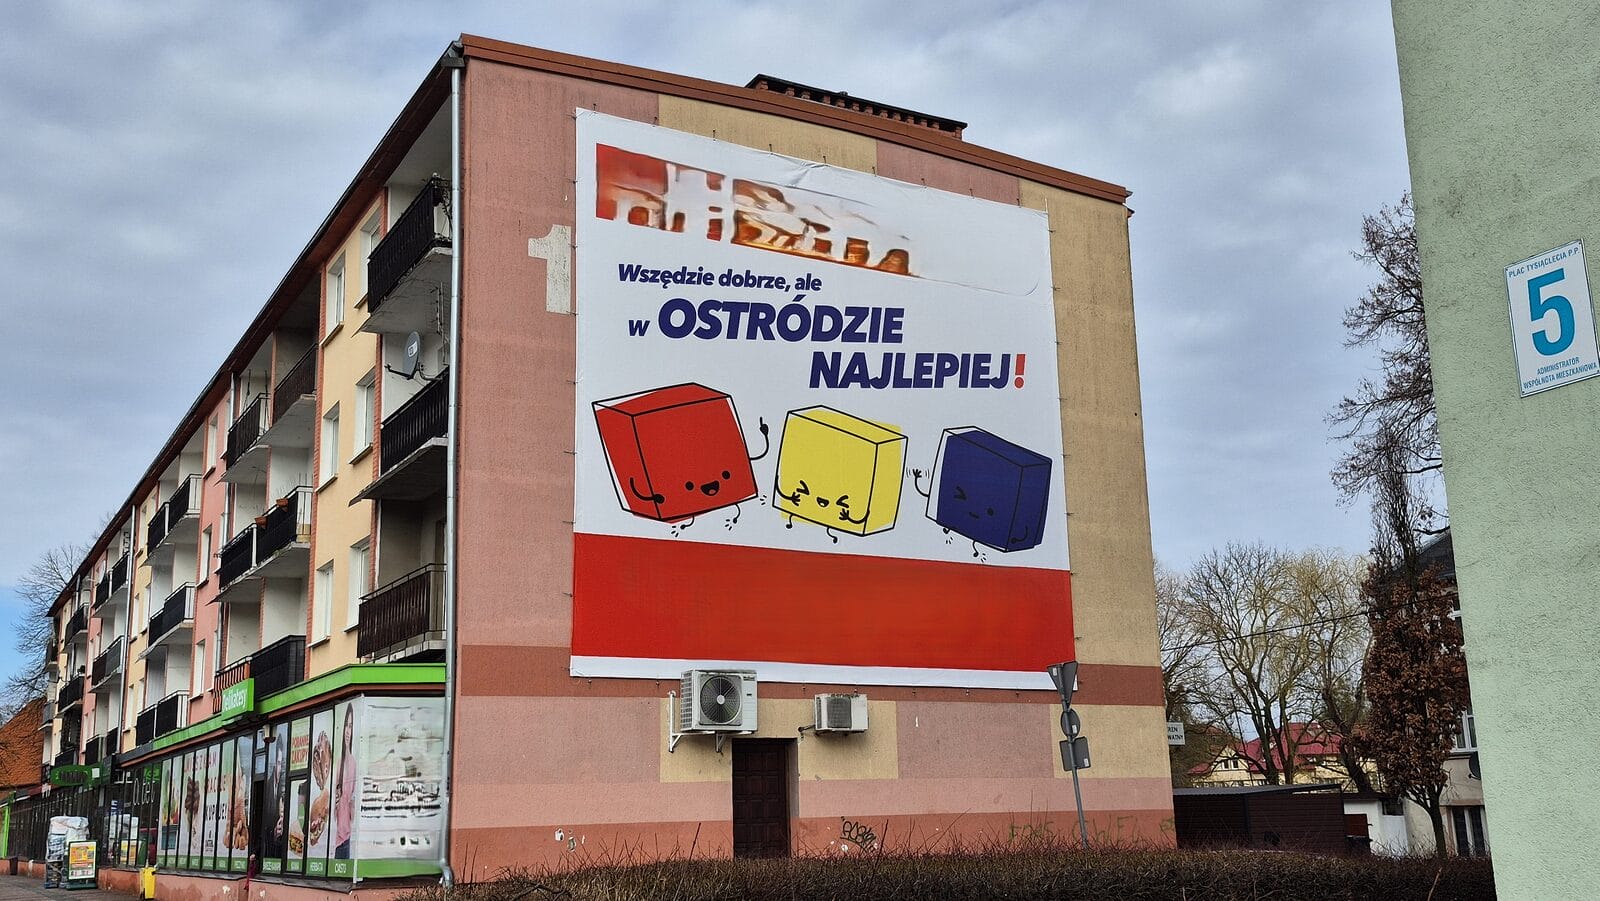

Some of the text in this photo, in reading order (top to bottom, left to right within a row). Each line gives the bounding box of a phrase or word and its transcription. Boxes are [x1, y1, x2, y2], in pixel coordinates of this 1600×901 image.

[618, 263, 823, 293] Wszędzie dobrze, ale
[1508, 266, 1525, 278] PLAC
[1527, 252, 1568, 271] TYSIĄCLECIA
[628, 293, 905, 344] w OSTRÓDZIE
[1527, 268, 1575, 356] 5
[809, 352, 1026, 390] NAJLEPIEJ!
[1523, 362, 1597, 389] WSPÓLNOTA MIESZKANIOWA
[1537, 356, 1580, 375] ADMINISTRATOR
